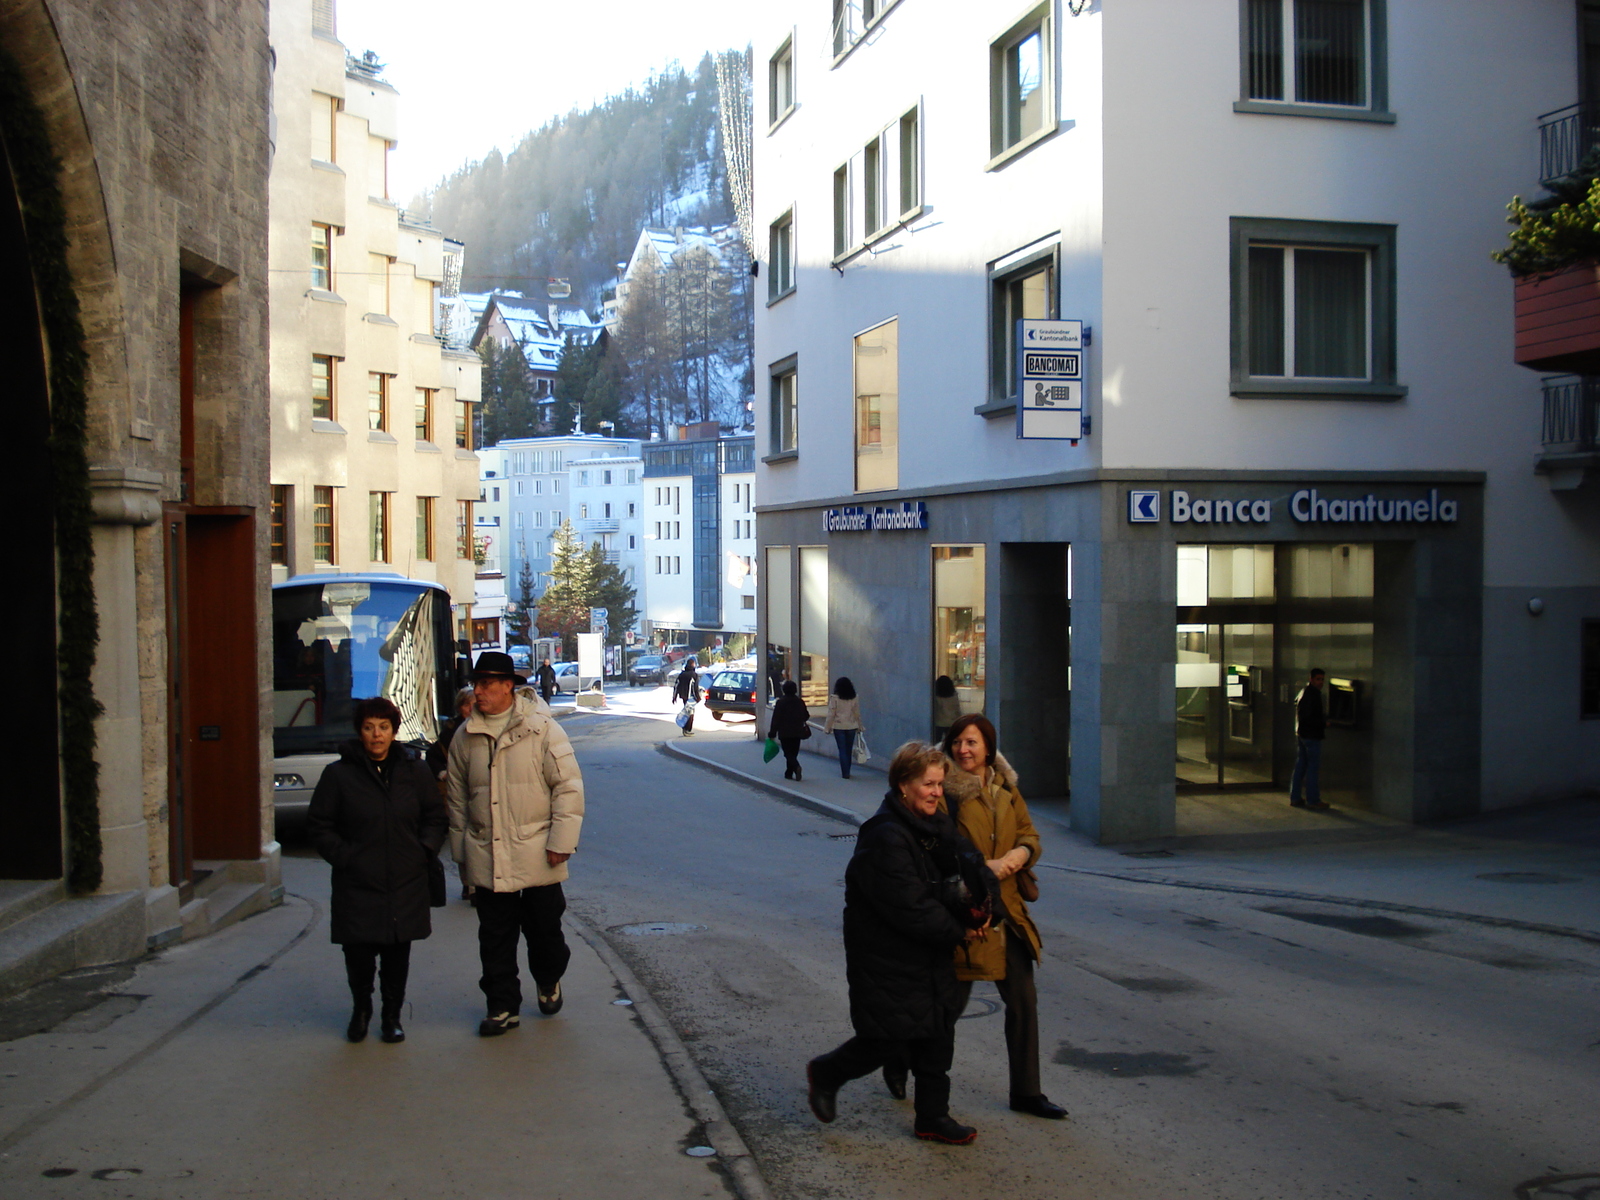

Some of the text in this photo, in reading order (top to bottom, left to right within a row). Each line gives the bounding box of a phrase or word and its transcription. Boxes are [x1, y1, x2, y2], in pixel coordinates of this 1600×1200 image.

[1029, 357, 1075, 372] BANCOMAT
[872, 502, 922, 530] Kantonalbank
[1171, 488, 1457, 523] Banca Chantunela
